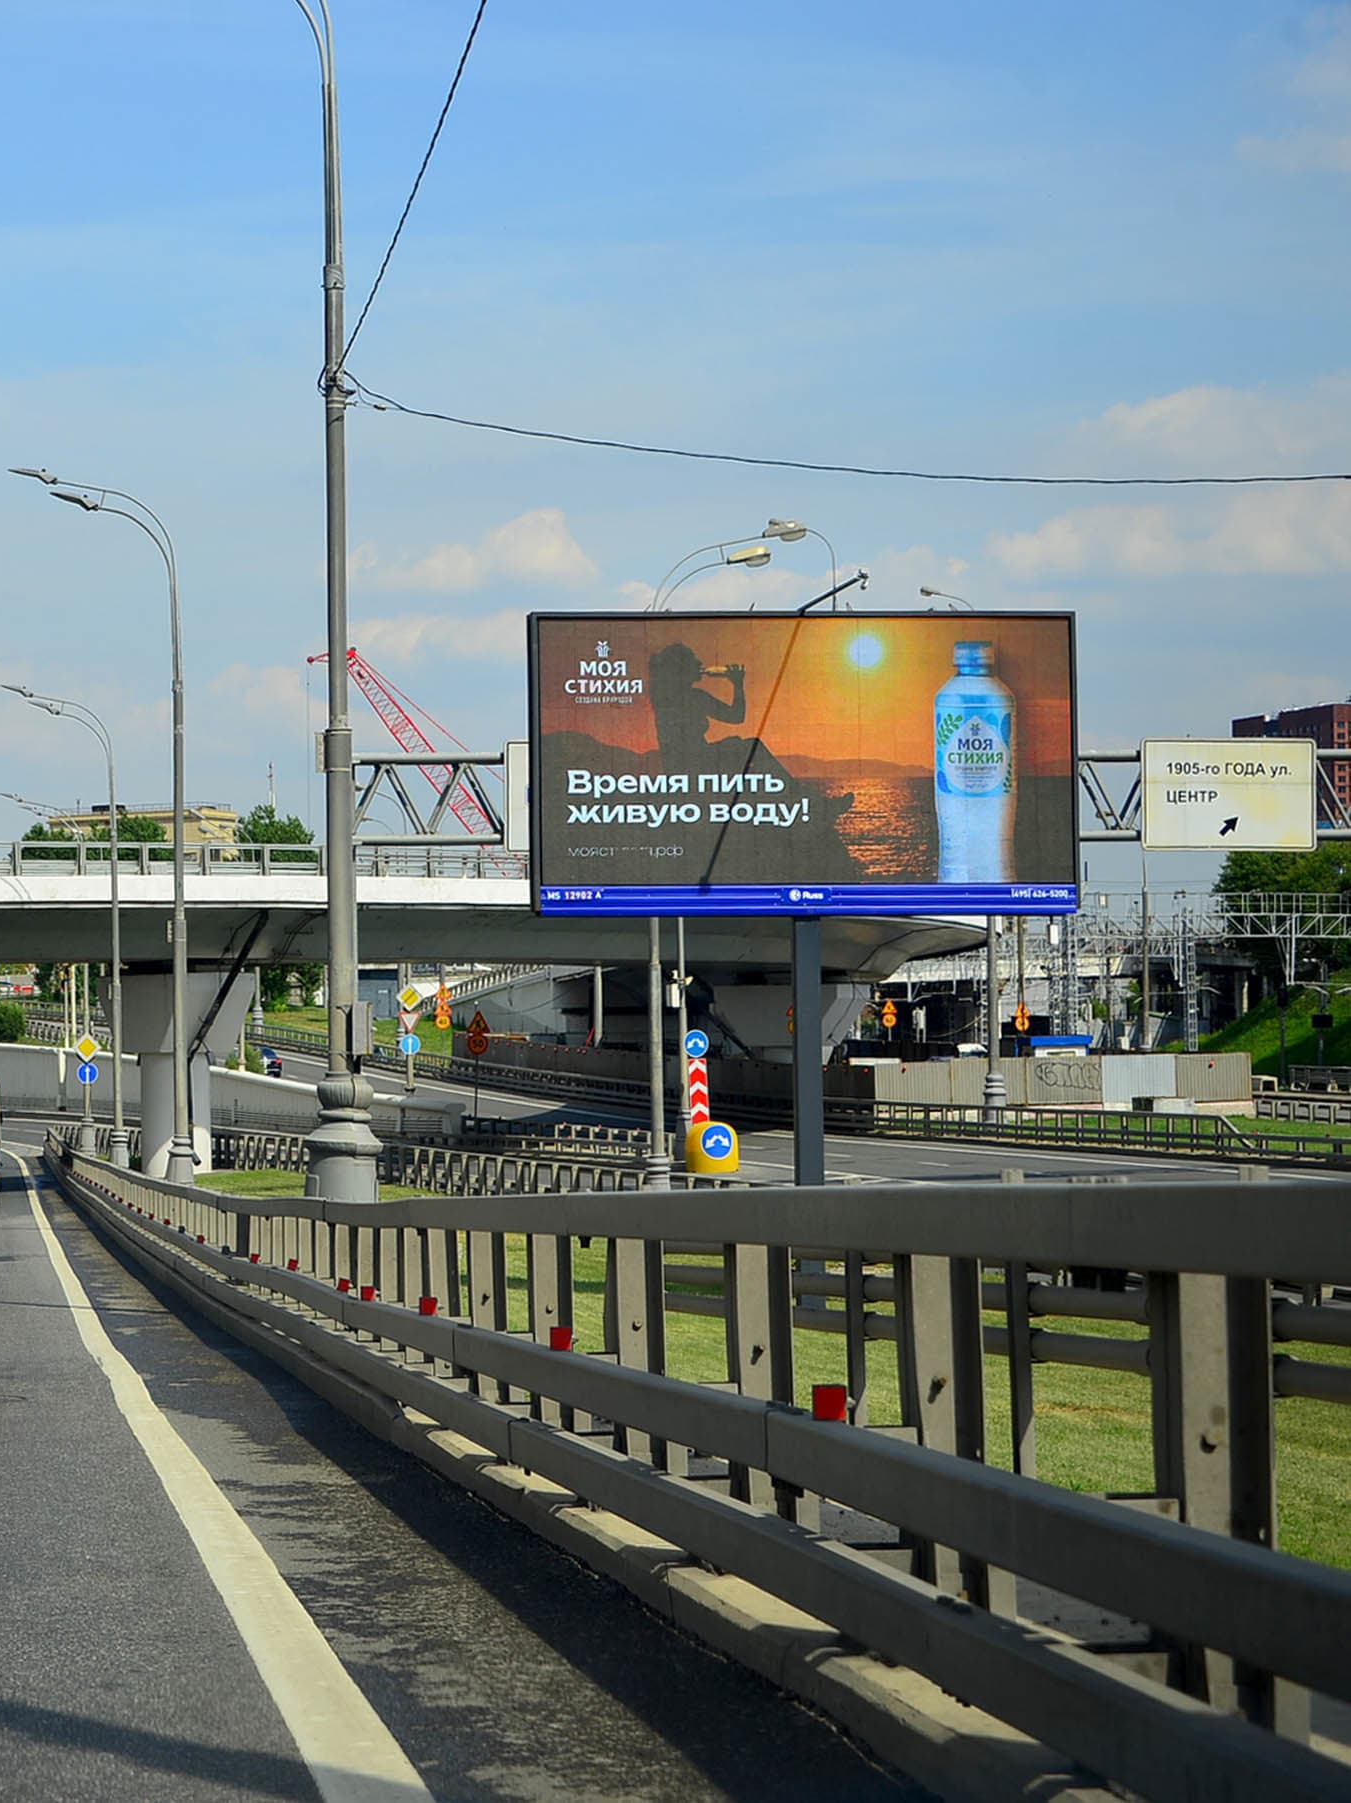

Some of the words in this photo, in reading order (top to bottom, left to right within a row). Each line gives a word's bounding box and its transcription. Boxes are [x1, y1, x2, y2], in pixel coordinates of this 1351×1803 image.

[579, 660, 627, 677] МОЯ
[564, 679, 643, 695] СТИХИЯ
[957, 738, 993, 751] МОЯ
[947, 752, 1004, 764] СТИХИЯ
[1166, 762, 1221, 776] 1905-го
[1225, 762, 1266, 778] ГОДА
[1269, 765, 1293, 778] ул.
[566, 769, 690, 799] Время
[697, 773, 786, 793] пить
[1166, 789, 1219, 804] ЦЕНТР
[566, 803, 702, 828] живую
[708, 797, 811, 828] воду!
